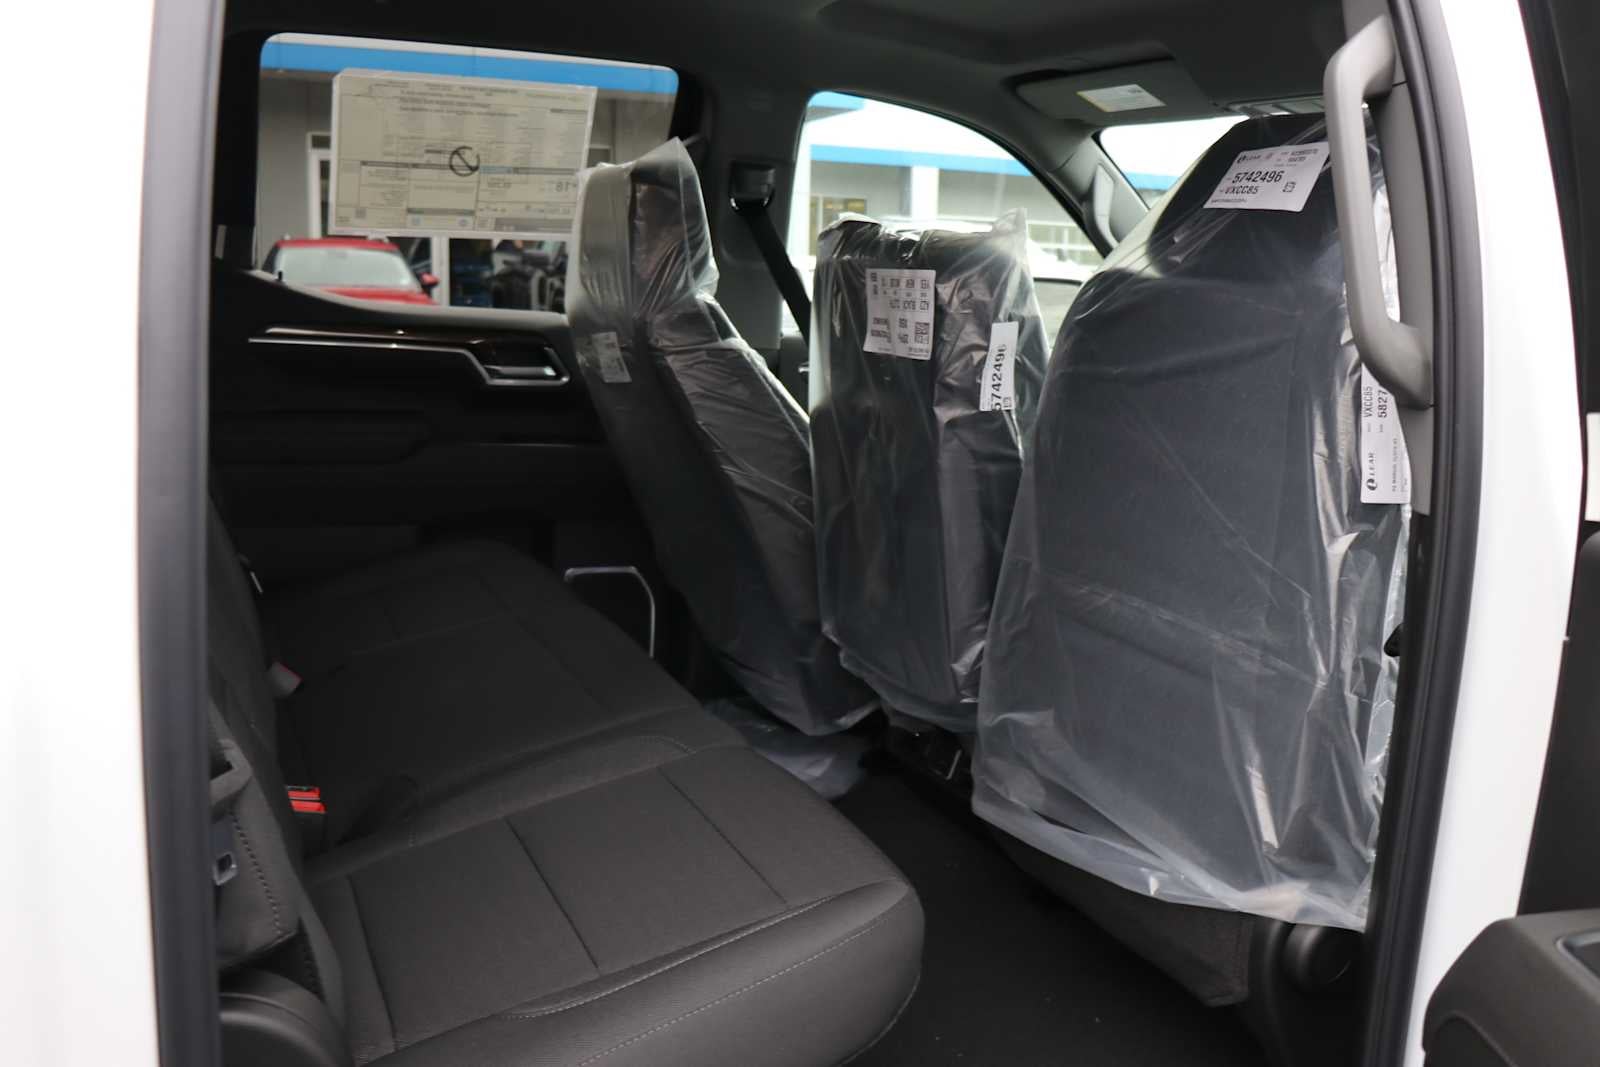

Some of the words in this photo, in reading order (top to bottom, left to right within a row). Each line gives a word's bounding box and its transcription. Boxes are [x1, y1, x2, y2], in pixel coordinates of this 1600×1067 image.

[1232, 170, 1285, 184] 5742496
[1225, 185, 1260, 195] VXCC85
[991, 343, 1007, 410] 5742496
[1363, 386, 1373, 418] VXCC85
